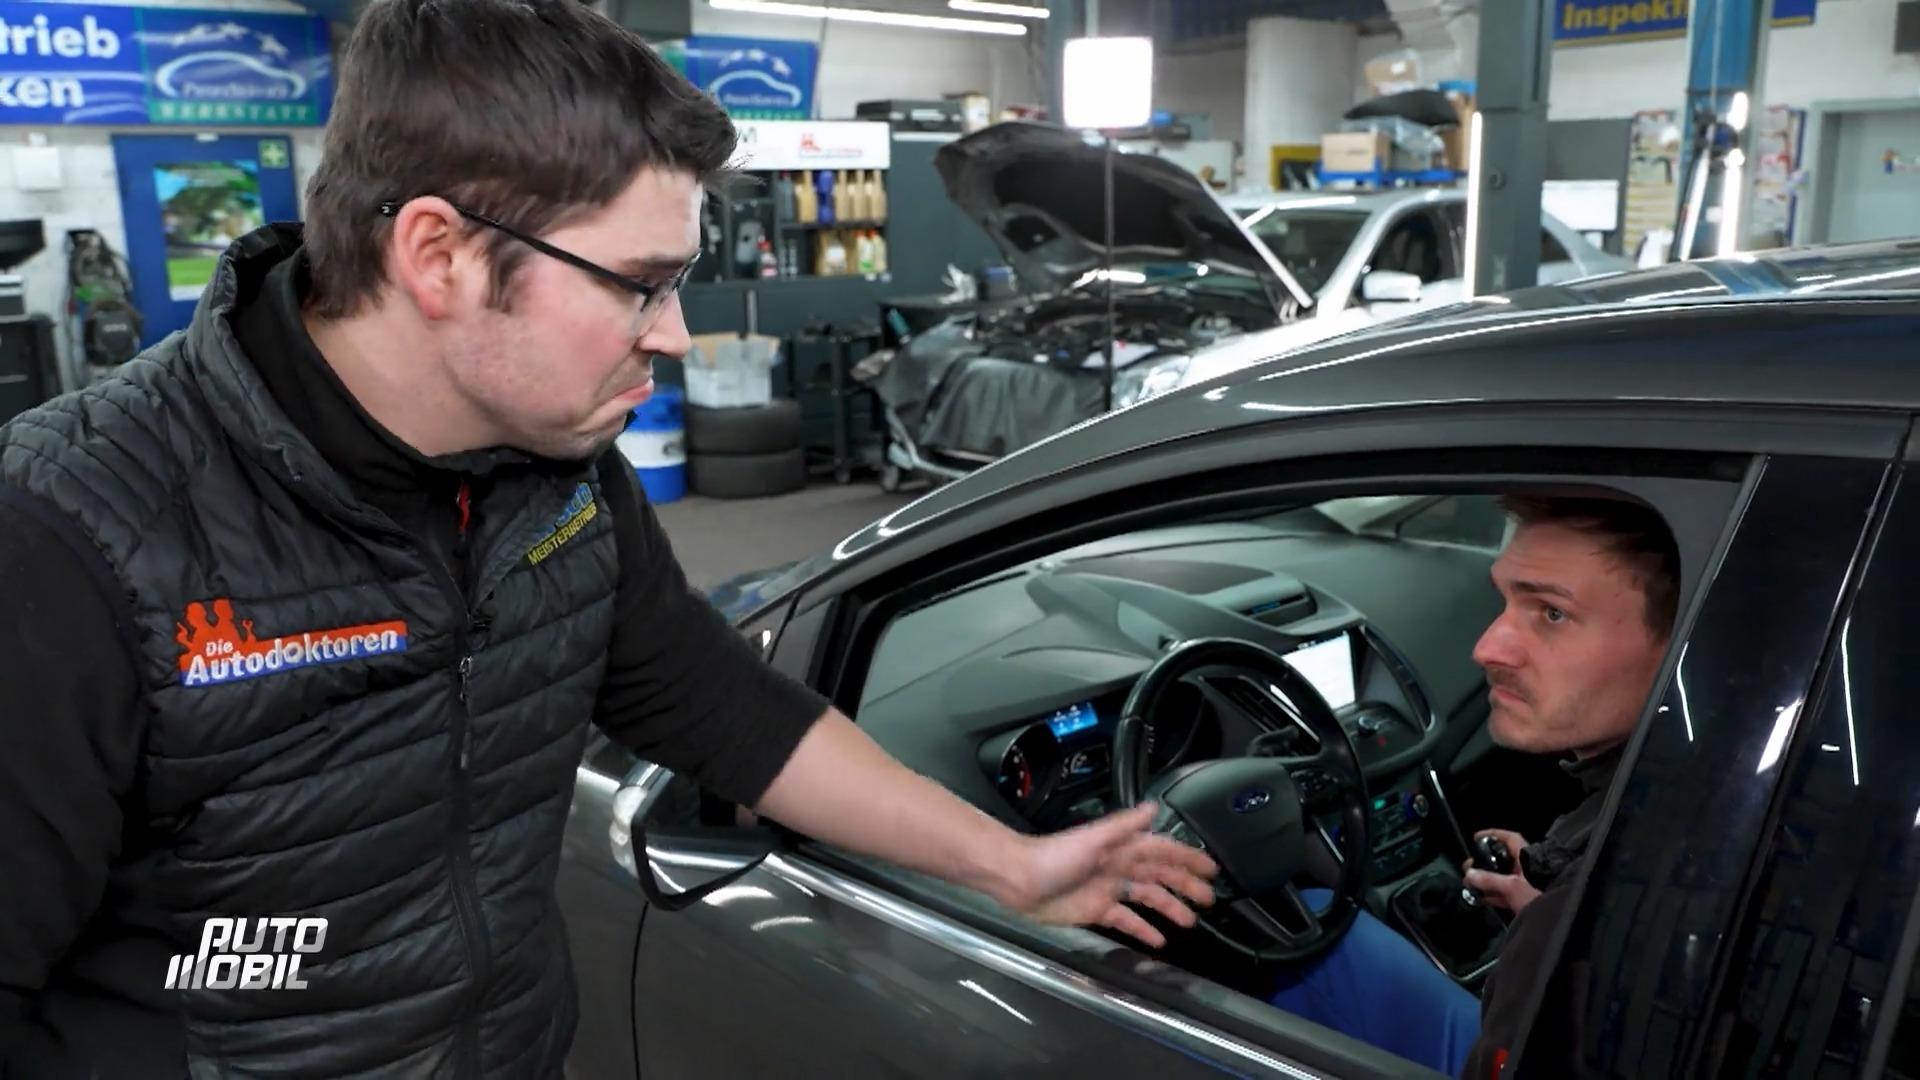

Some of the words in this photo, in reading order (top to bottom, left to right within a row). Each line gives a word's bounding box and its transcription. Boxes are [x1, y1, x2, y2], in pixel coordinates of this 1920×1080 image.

[159, 103, 308, 121] WERKSTATT
[205, 639, 234, 657] Die
[184, 629, 399, 686] Autodoktoren
